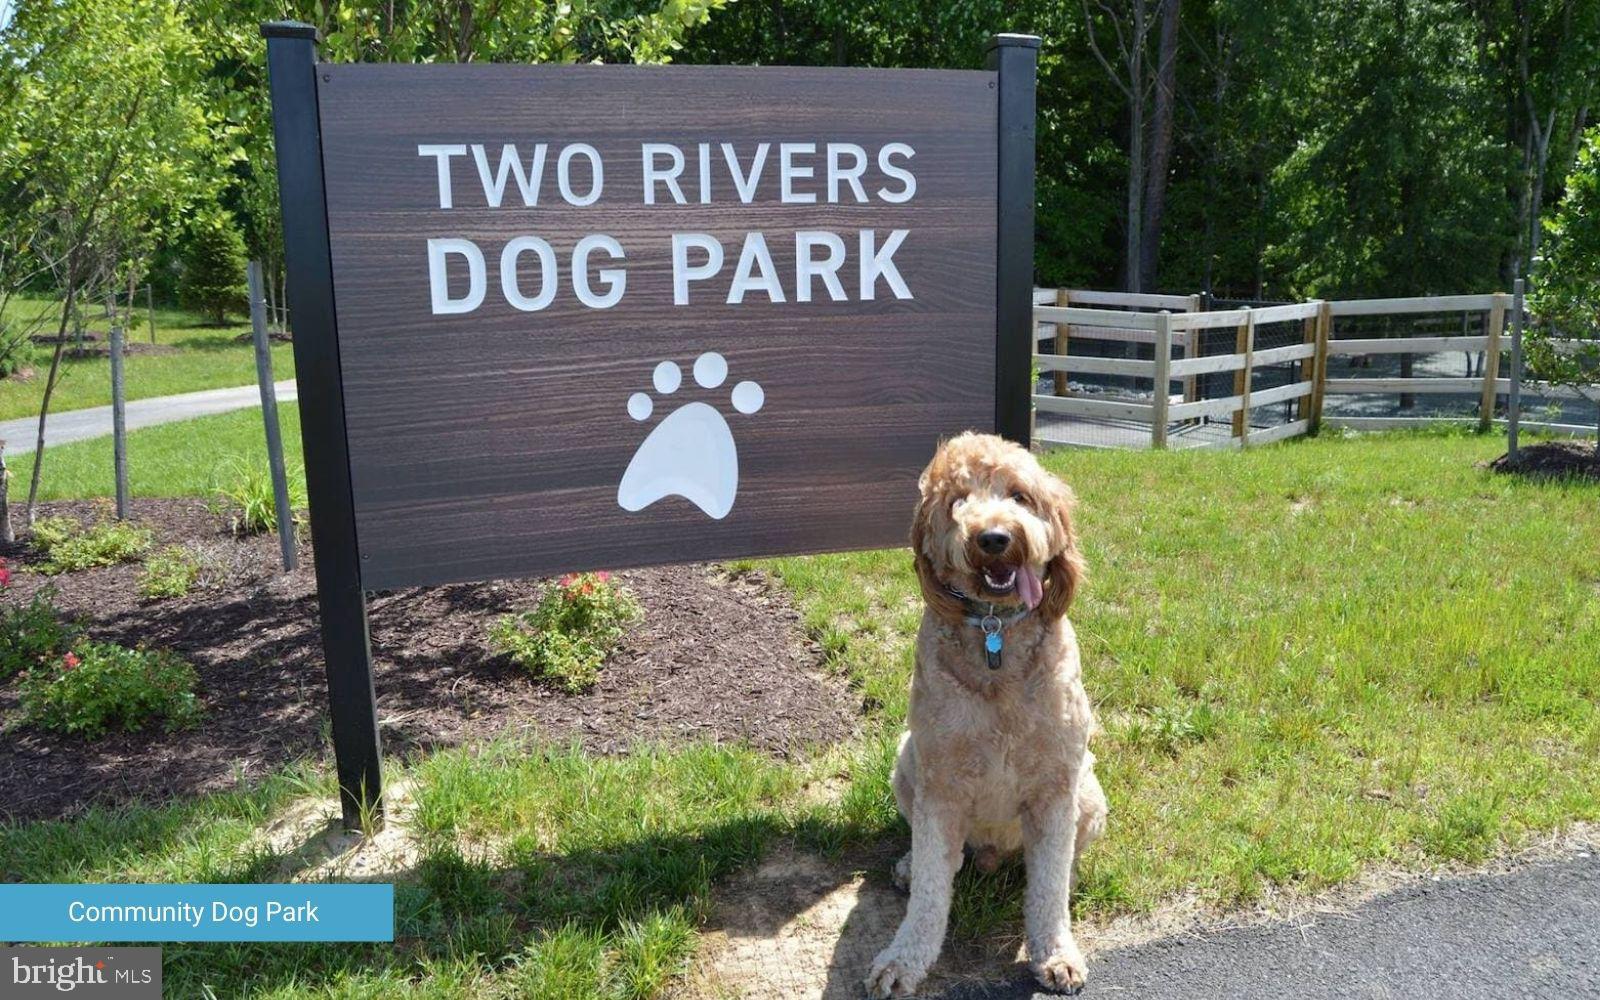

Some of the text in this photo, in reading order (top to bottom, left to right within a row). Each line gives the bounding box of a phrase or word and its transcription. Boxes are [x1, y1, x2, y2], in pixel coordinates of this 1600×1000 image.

[417, 142, 917, 209] TWO RIVERS
[426, 228, 914, 315] DOG PARK
